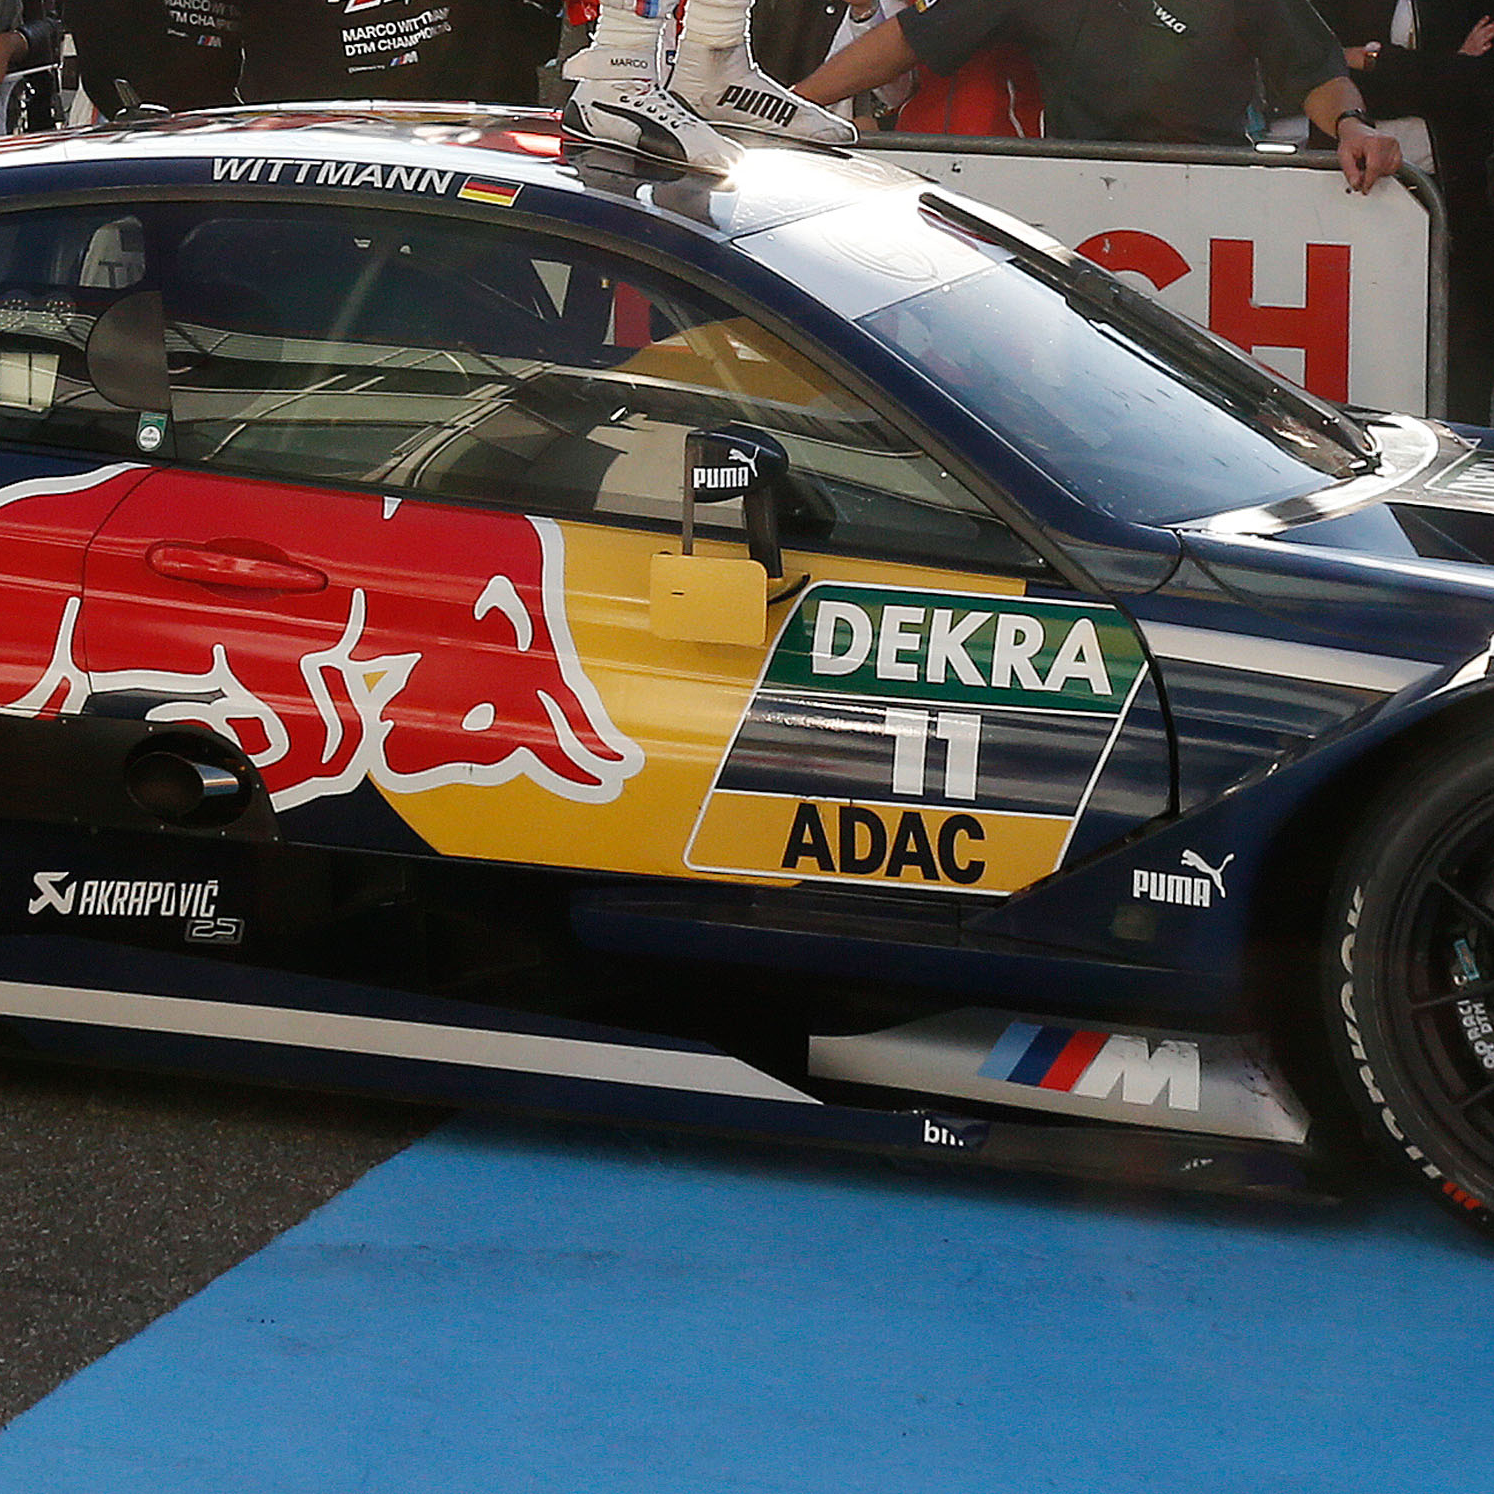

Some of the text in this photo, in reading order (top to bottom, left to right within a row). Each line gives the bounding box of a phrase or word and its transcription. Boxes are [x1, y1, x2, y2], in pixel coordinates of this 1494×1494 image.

[342, 22, 397, 44] MARCO
[345, 40, 377, 57] DTM
[610, 58, 649, 70] MARCO
[717, 84, 799, 128] PUMA
[211, 157, 455, 195] WITTMANN
[693, 465, 750, 489] PUMA
[811, 599, 1114, 696] DEKRA
[883, 706, 983, 802] 11
[780, 802, 987, 886] ADAC
[1132, 869, 1211, 907] PUMA
